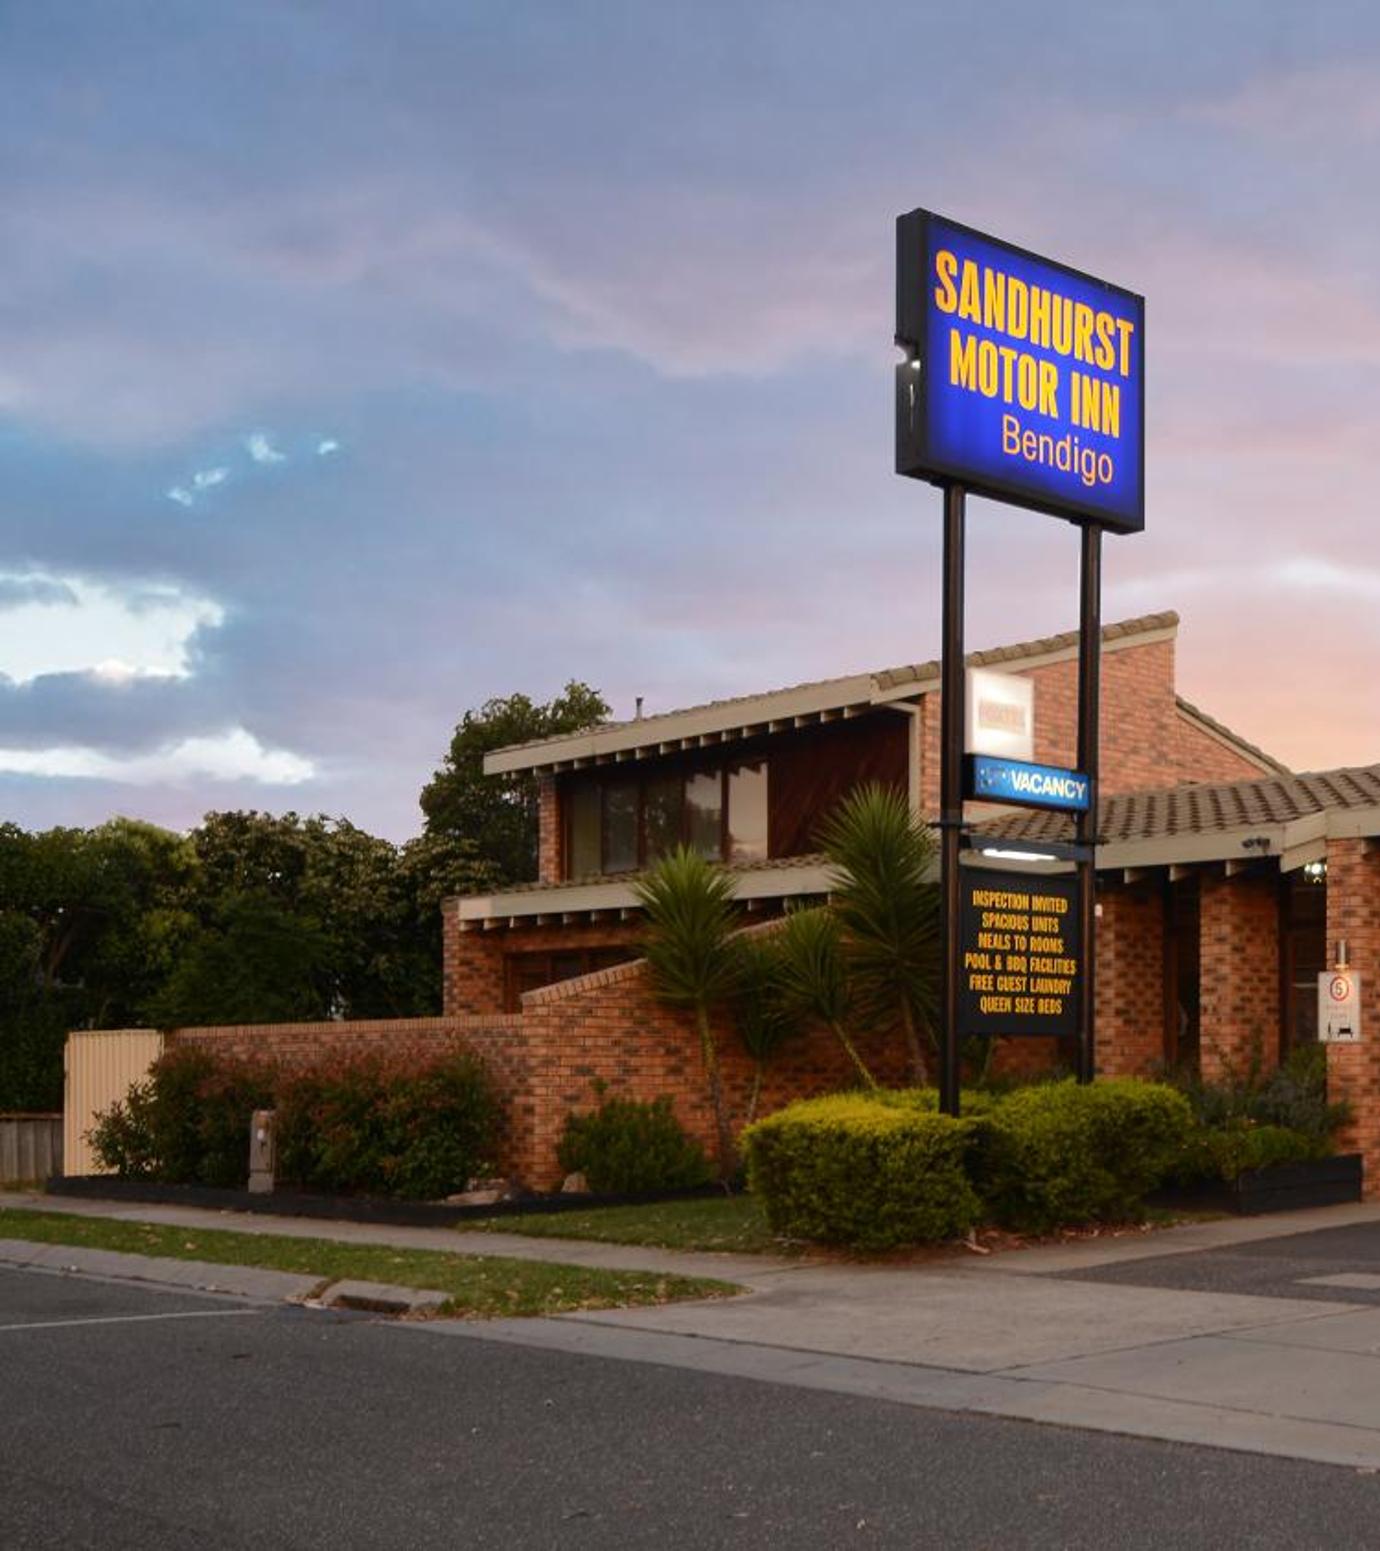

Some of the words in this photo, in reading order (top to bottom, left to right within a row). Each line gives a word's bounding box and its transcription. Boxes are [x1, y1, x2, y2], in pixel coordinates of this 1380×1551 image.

[935, 248, 1134, 377] SANDHURST
[949, 330, 1058, 419] MOTOR
[1071, 371, 1121, 438] INN
[1002, 416, 1114, 487] Bendigo
[1010, 769, 1086, 799] VACANCY
[972, 889, 1030, 910] INSPECTION
[1031, 895, 1068, 913] INVITED
[982, 911, 1029, 930] SPACIOUS
[1032, 916, 1059, 933] UNITS
[978, 932, 1011, 950] MEALS
[1015, 935, 1027, 951] TO
[1030, 936, 1064, 954] ROOMS
[965, 952, 992, 970] POOL
[995, 954, 1002, 970] &
[1006, 956, 1027, 973] BBQ
[1030, 957, 1076, 974] FACILITIES
[969, 974, 994, 991] FREE
[997, 975, 1027, 992] GUEST
[1030, 977, 1071, 995] LAUNDRY
[980, 995, 1011, 1014] QUEEN
[1015, 997, 1035, 1013] SIZE
[1037, 998, 1062, 1014] BEDS
